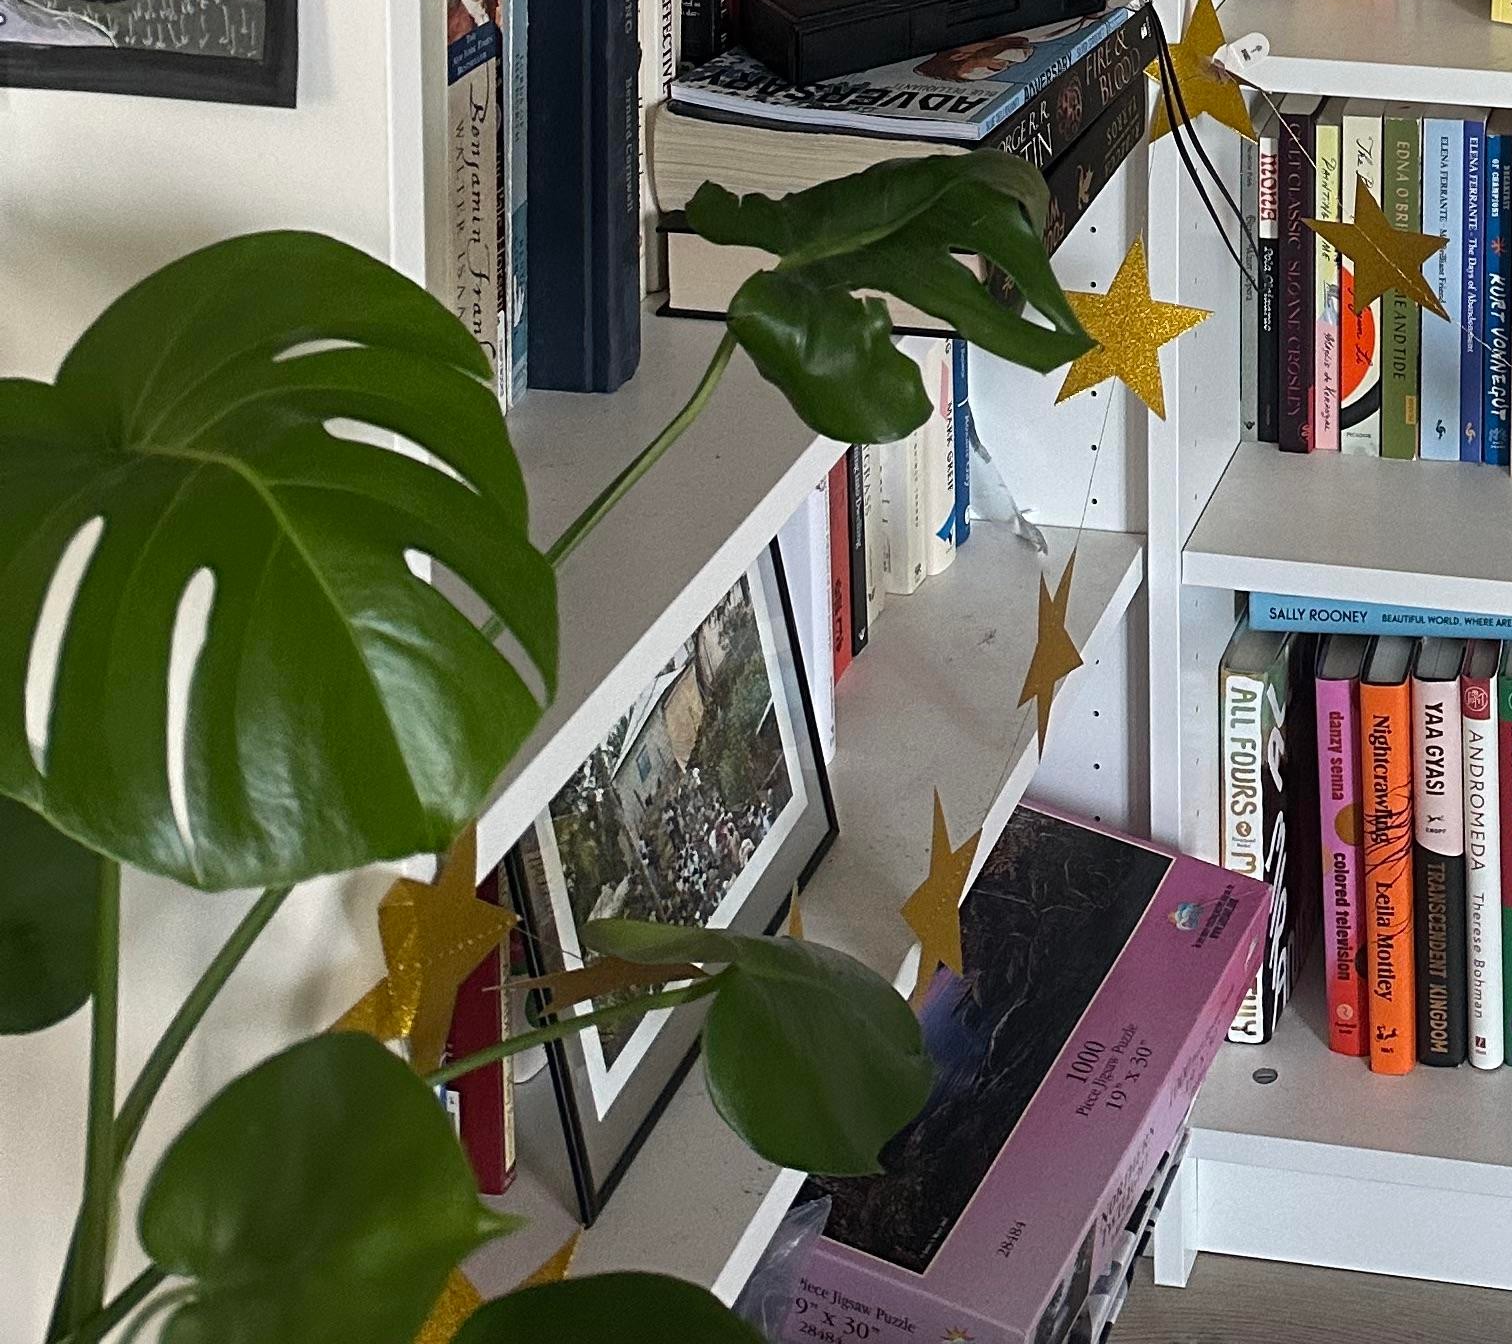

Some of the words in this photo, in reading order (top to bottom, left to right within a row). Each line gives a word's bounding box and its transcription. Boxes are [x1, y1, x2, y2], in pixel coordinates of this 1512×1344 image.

[1269, 607, 1305, 622] SALLY
[1310, 609, 1367, 623] ROONEY
[1425, 701, 1444, 737] YAA
[1425, 742, 1445, 795] GYASI
[1065, 1040, 1106, 1085] 1000
